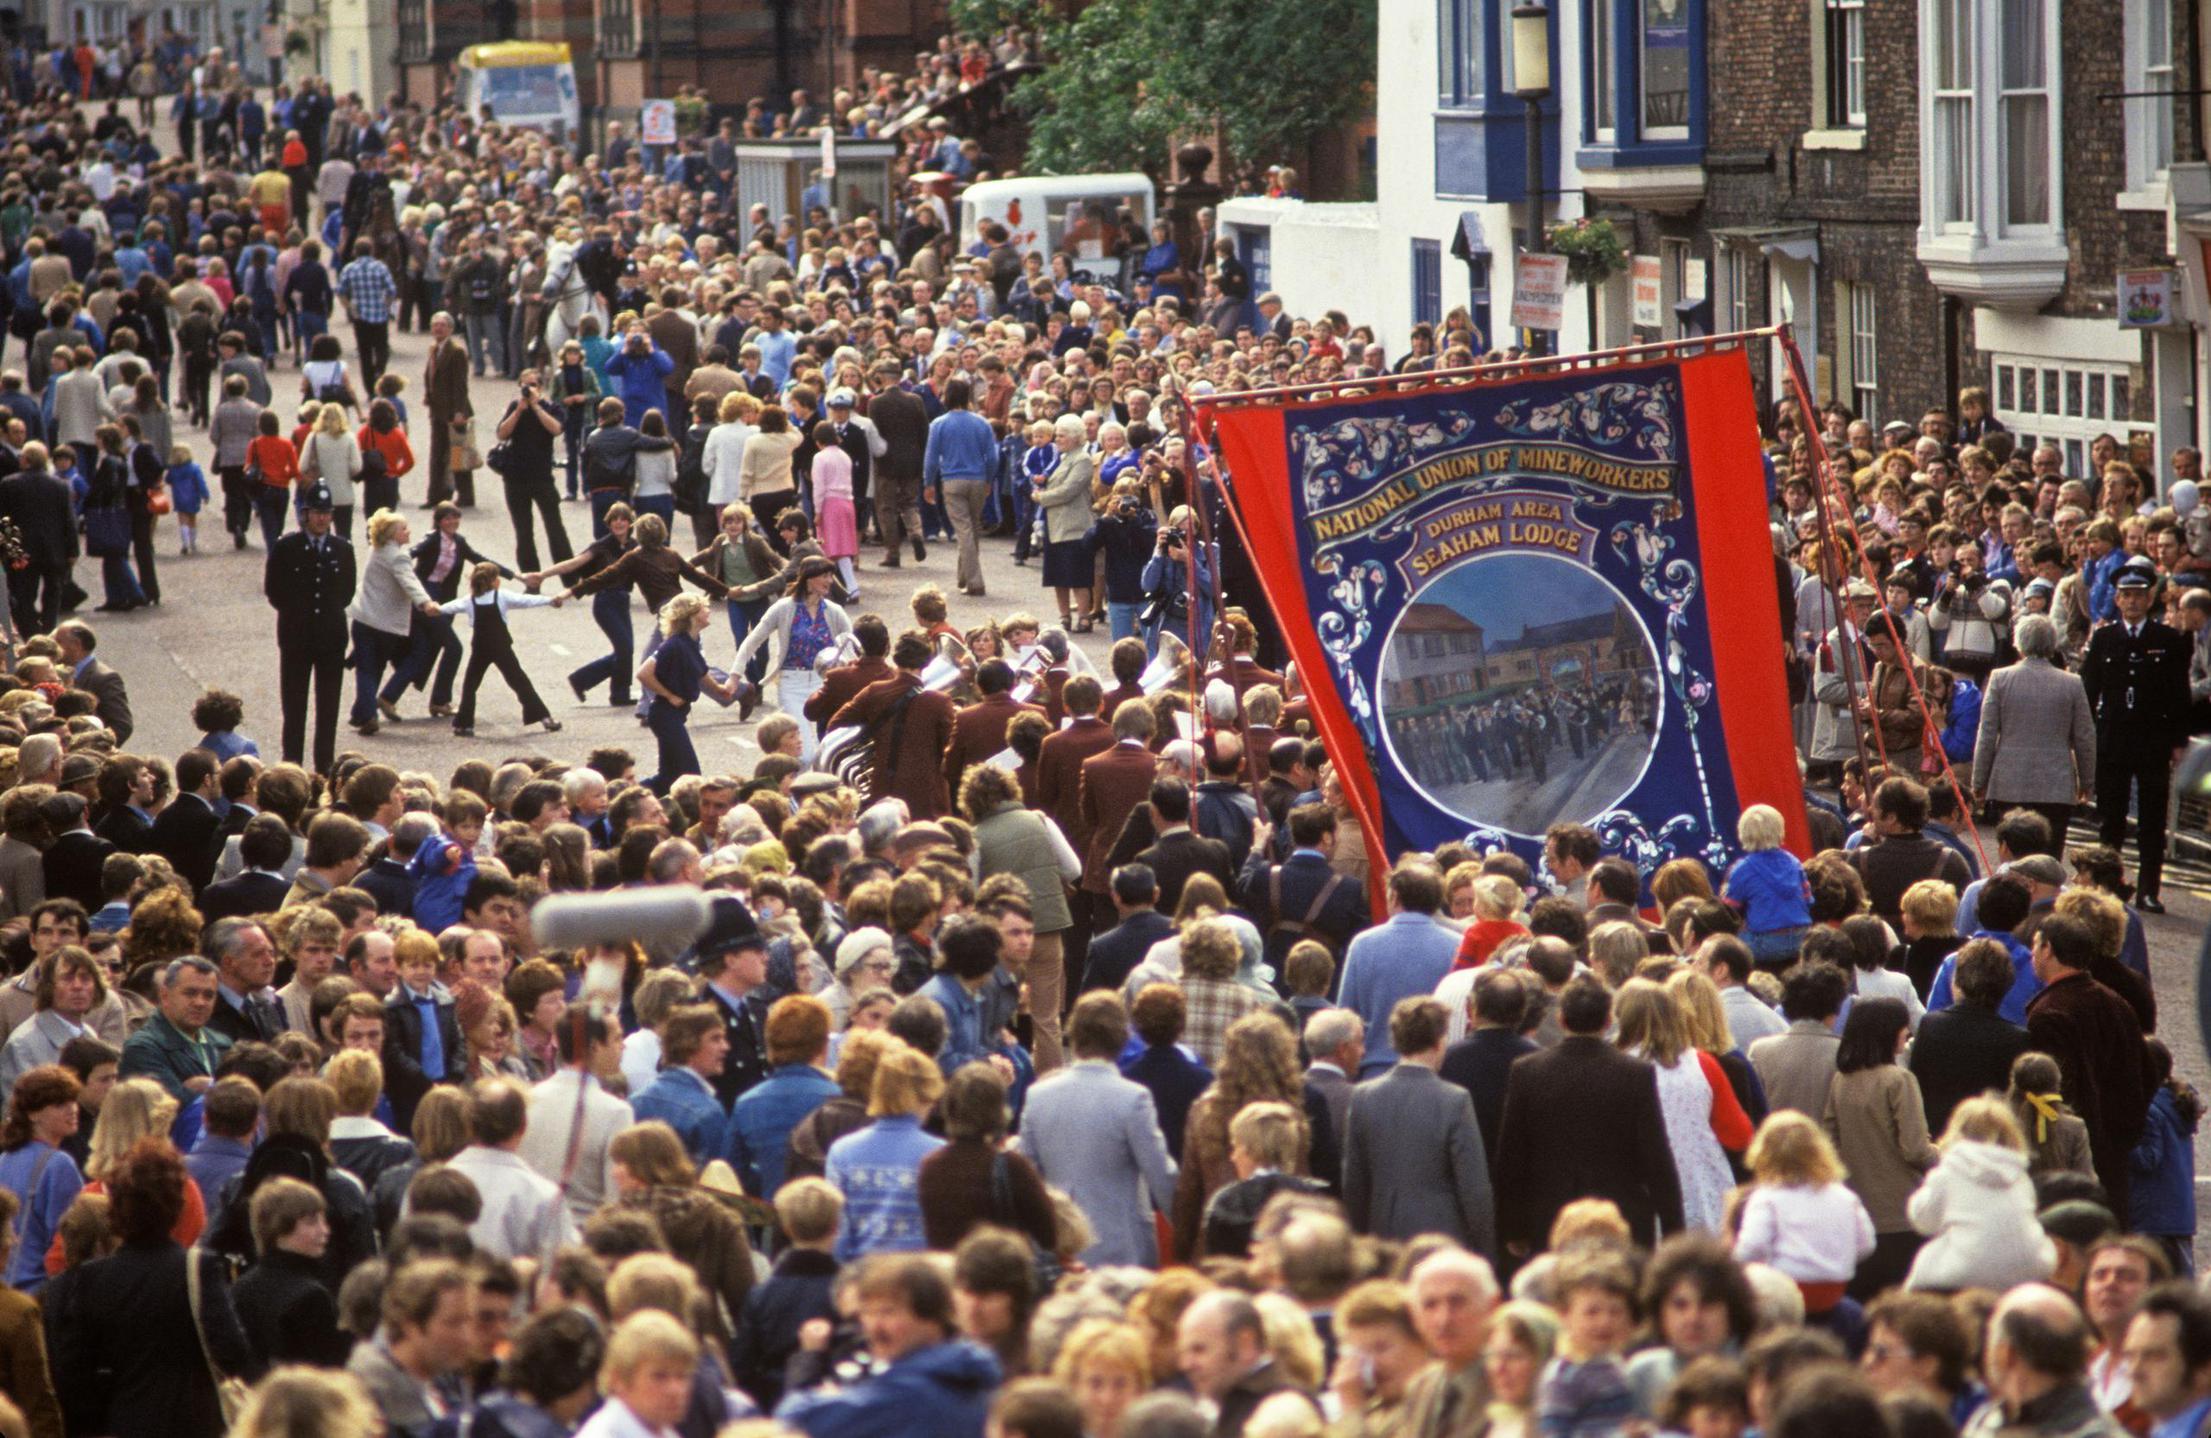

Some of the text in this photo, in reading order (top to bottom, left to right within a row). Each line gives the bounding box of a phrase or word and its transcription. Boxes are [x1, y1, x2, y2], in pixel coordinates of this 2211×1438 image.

[1314, 448, 1670, 541] NATIONAL UNION OF MINEWORKERS
[1426, 501, 1562, 538] DURHAM AREA
[1412, 523, 1582, 577] SEAHAM LODGE
